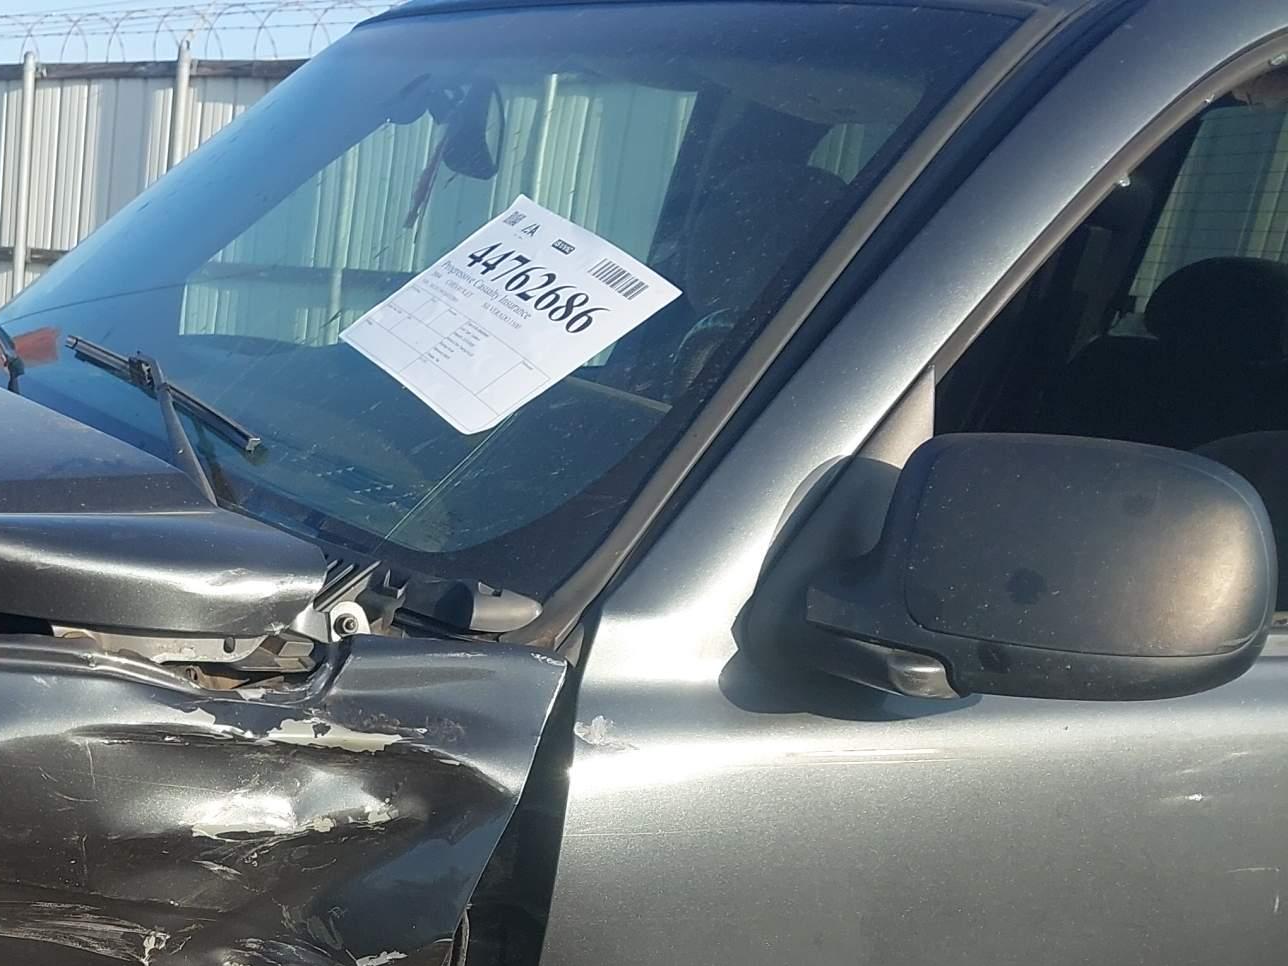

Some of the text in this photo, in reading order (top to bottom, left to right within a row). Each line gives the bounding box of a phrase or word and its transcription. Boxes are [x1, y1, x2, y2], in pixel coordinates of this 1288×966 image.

[441, 260, 475, 284] Progressive
[473, 278, 500, 301] Casualty
[497, 294, 532, 320] Insurance
[468, 242, 611, 334] 44762686
